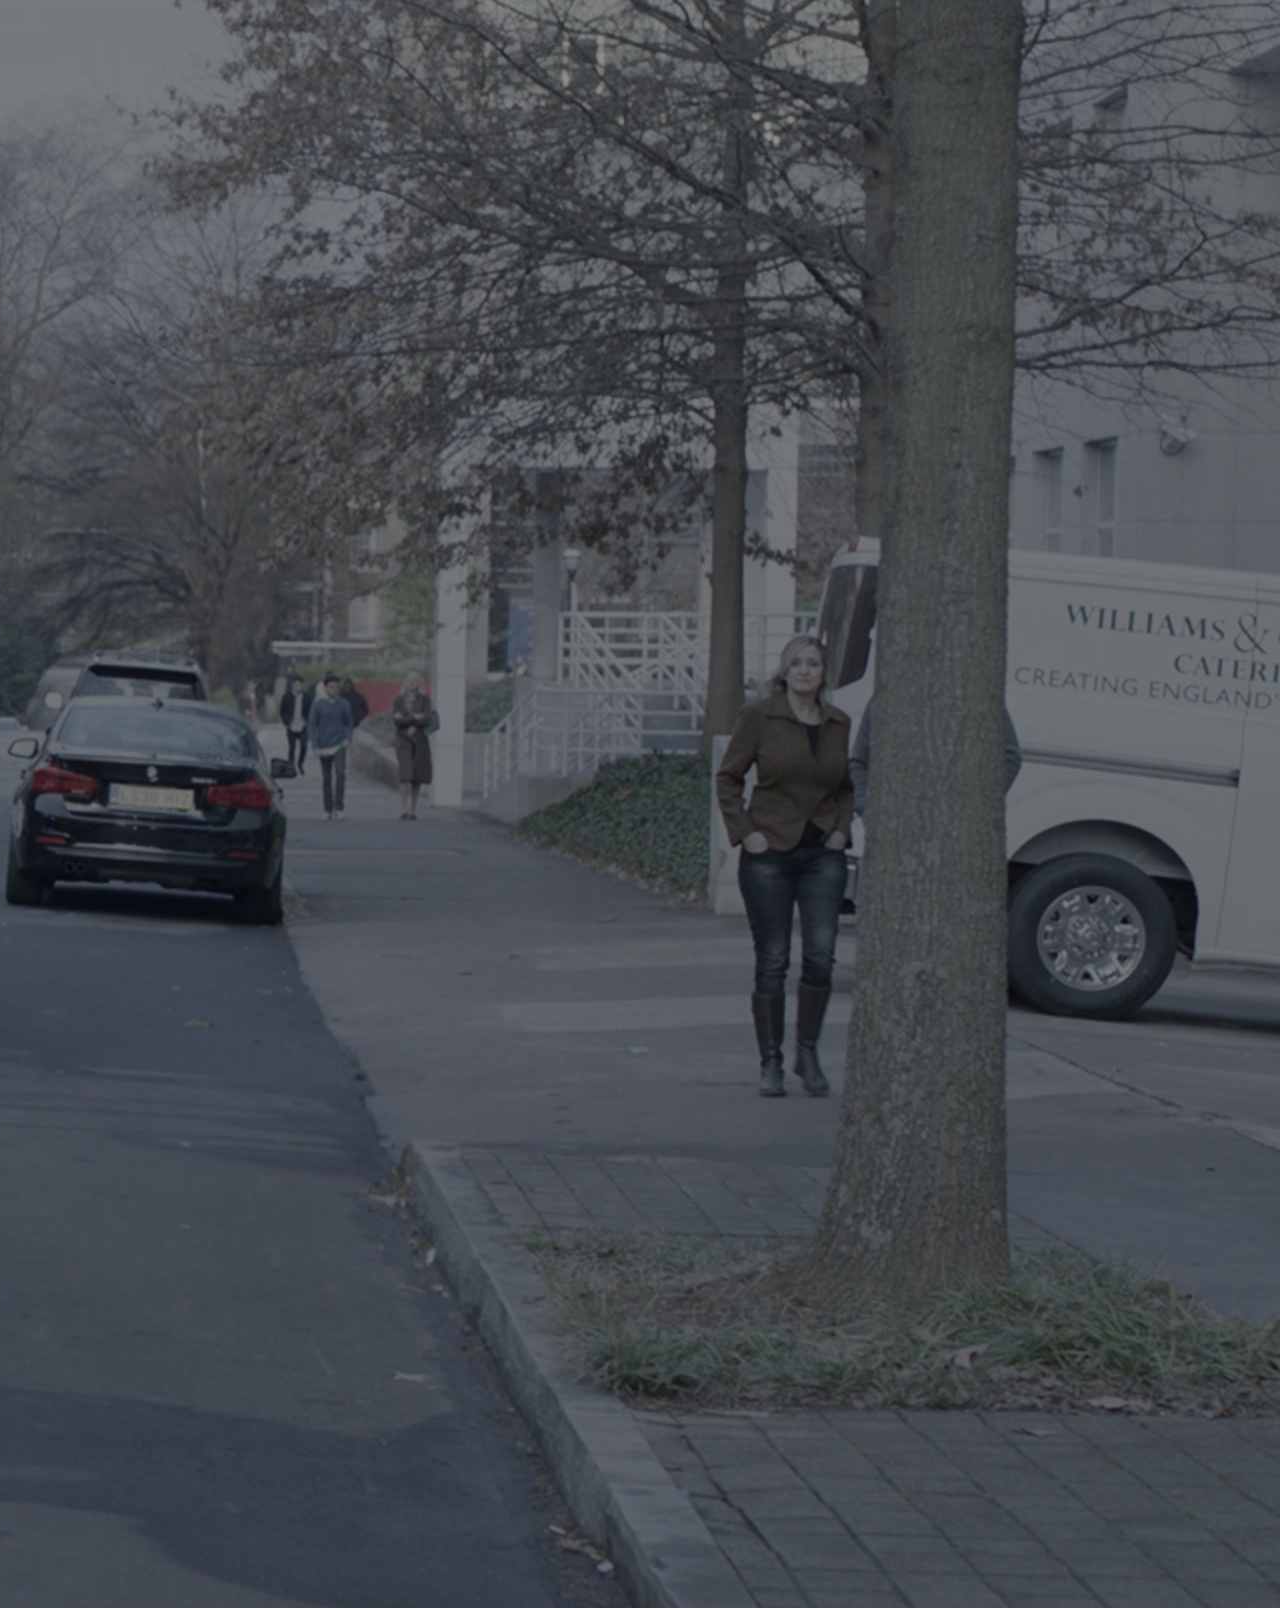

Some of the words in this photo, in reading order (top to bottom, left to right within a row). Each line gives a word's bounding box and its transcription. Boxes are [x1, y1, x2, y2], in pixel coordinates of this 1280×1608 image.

[1066, 604, 1226, 641] WILLIAMS
[1233, 612, 1270, 654] &
[1014, 666, 1139, 697] CREATING
